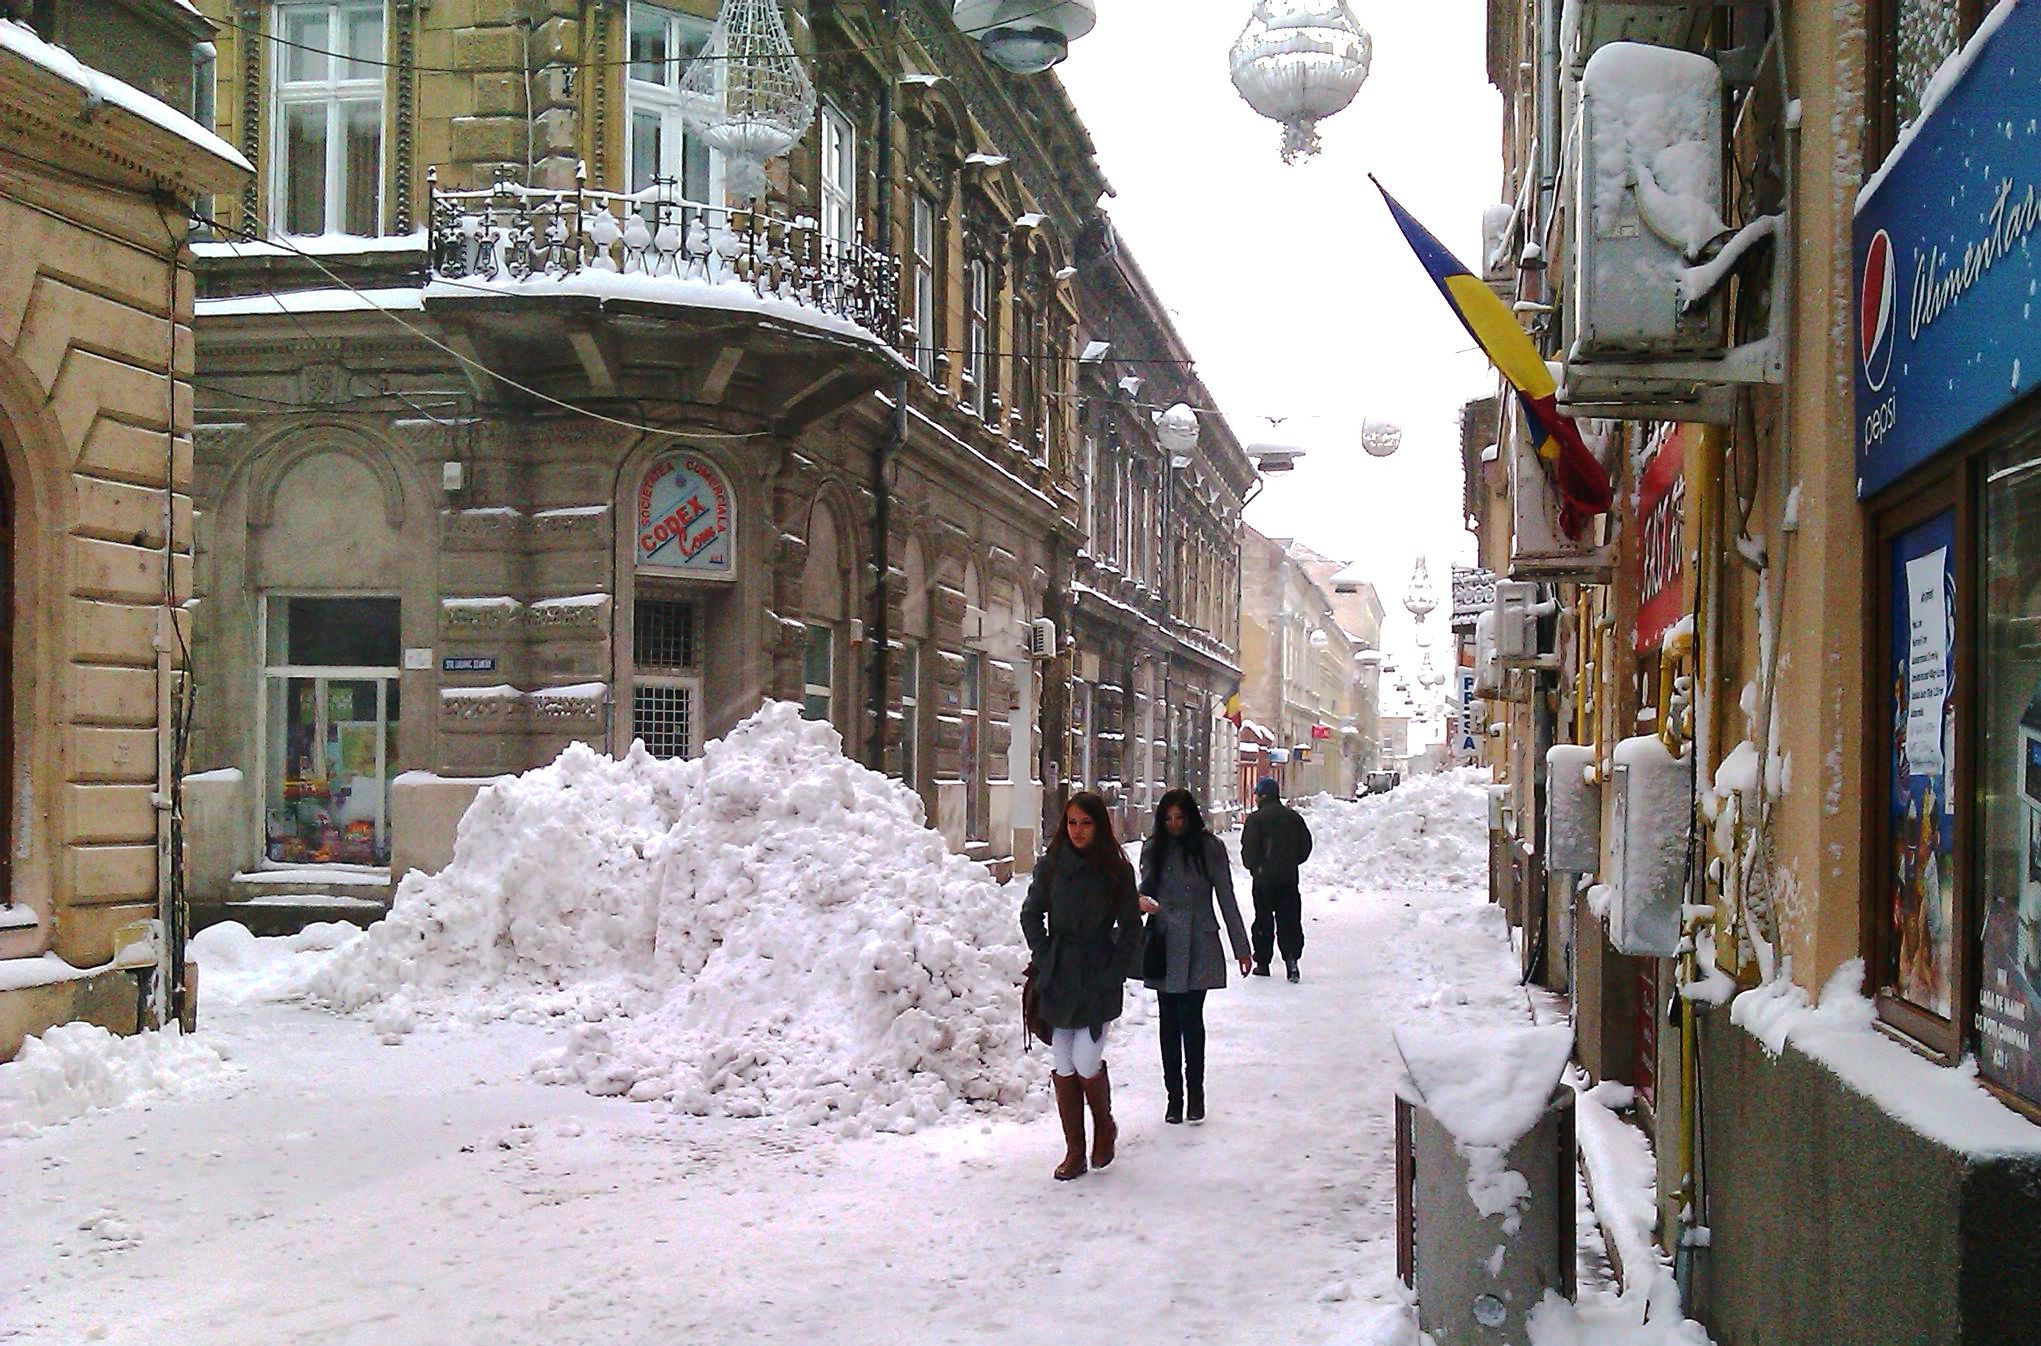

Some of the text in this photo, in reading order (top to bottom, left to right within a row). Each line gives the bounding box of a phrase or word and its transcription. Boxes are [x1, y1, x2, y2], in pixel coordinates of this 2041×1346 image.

[1911, 176, 2041, 341] Alimentar
[1864, 392, 1896, 455] pepsi
[641, 495, 706, 552] CODEX
